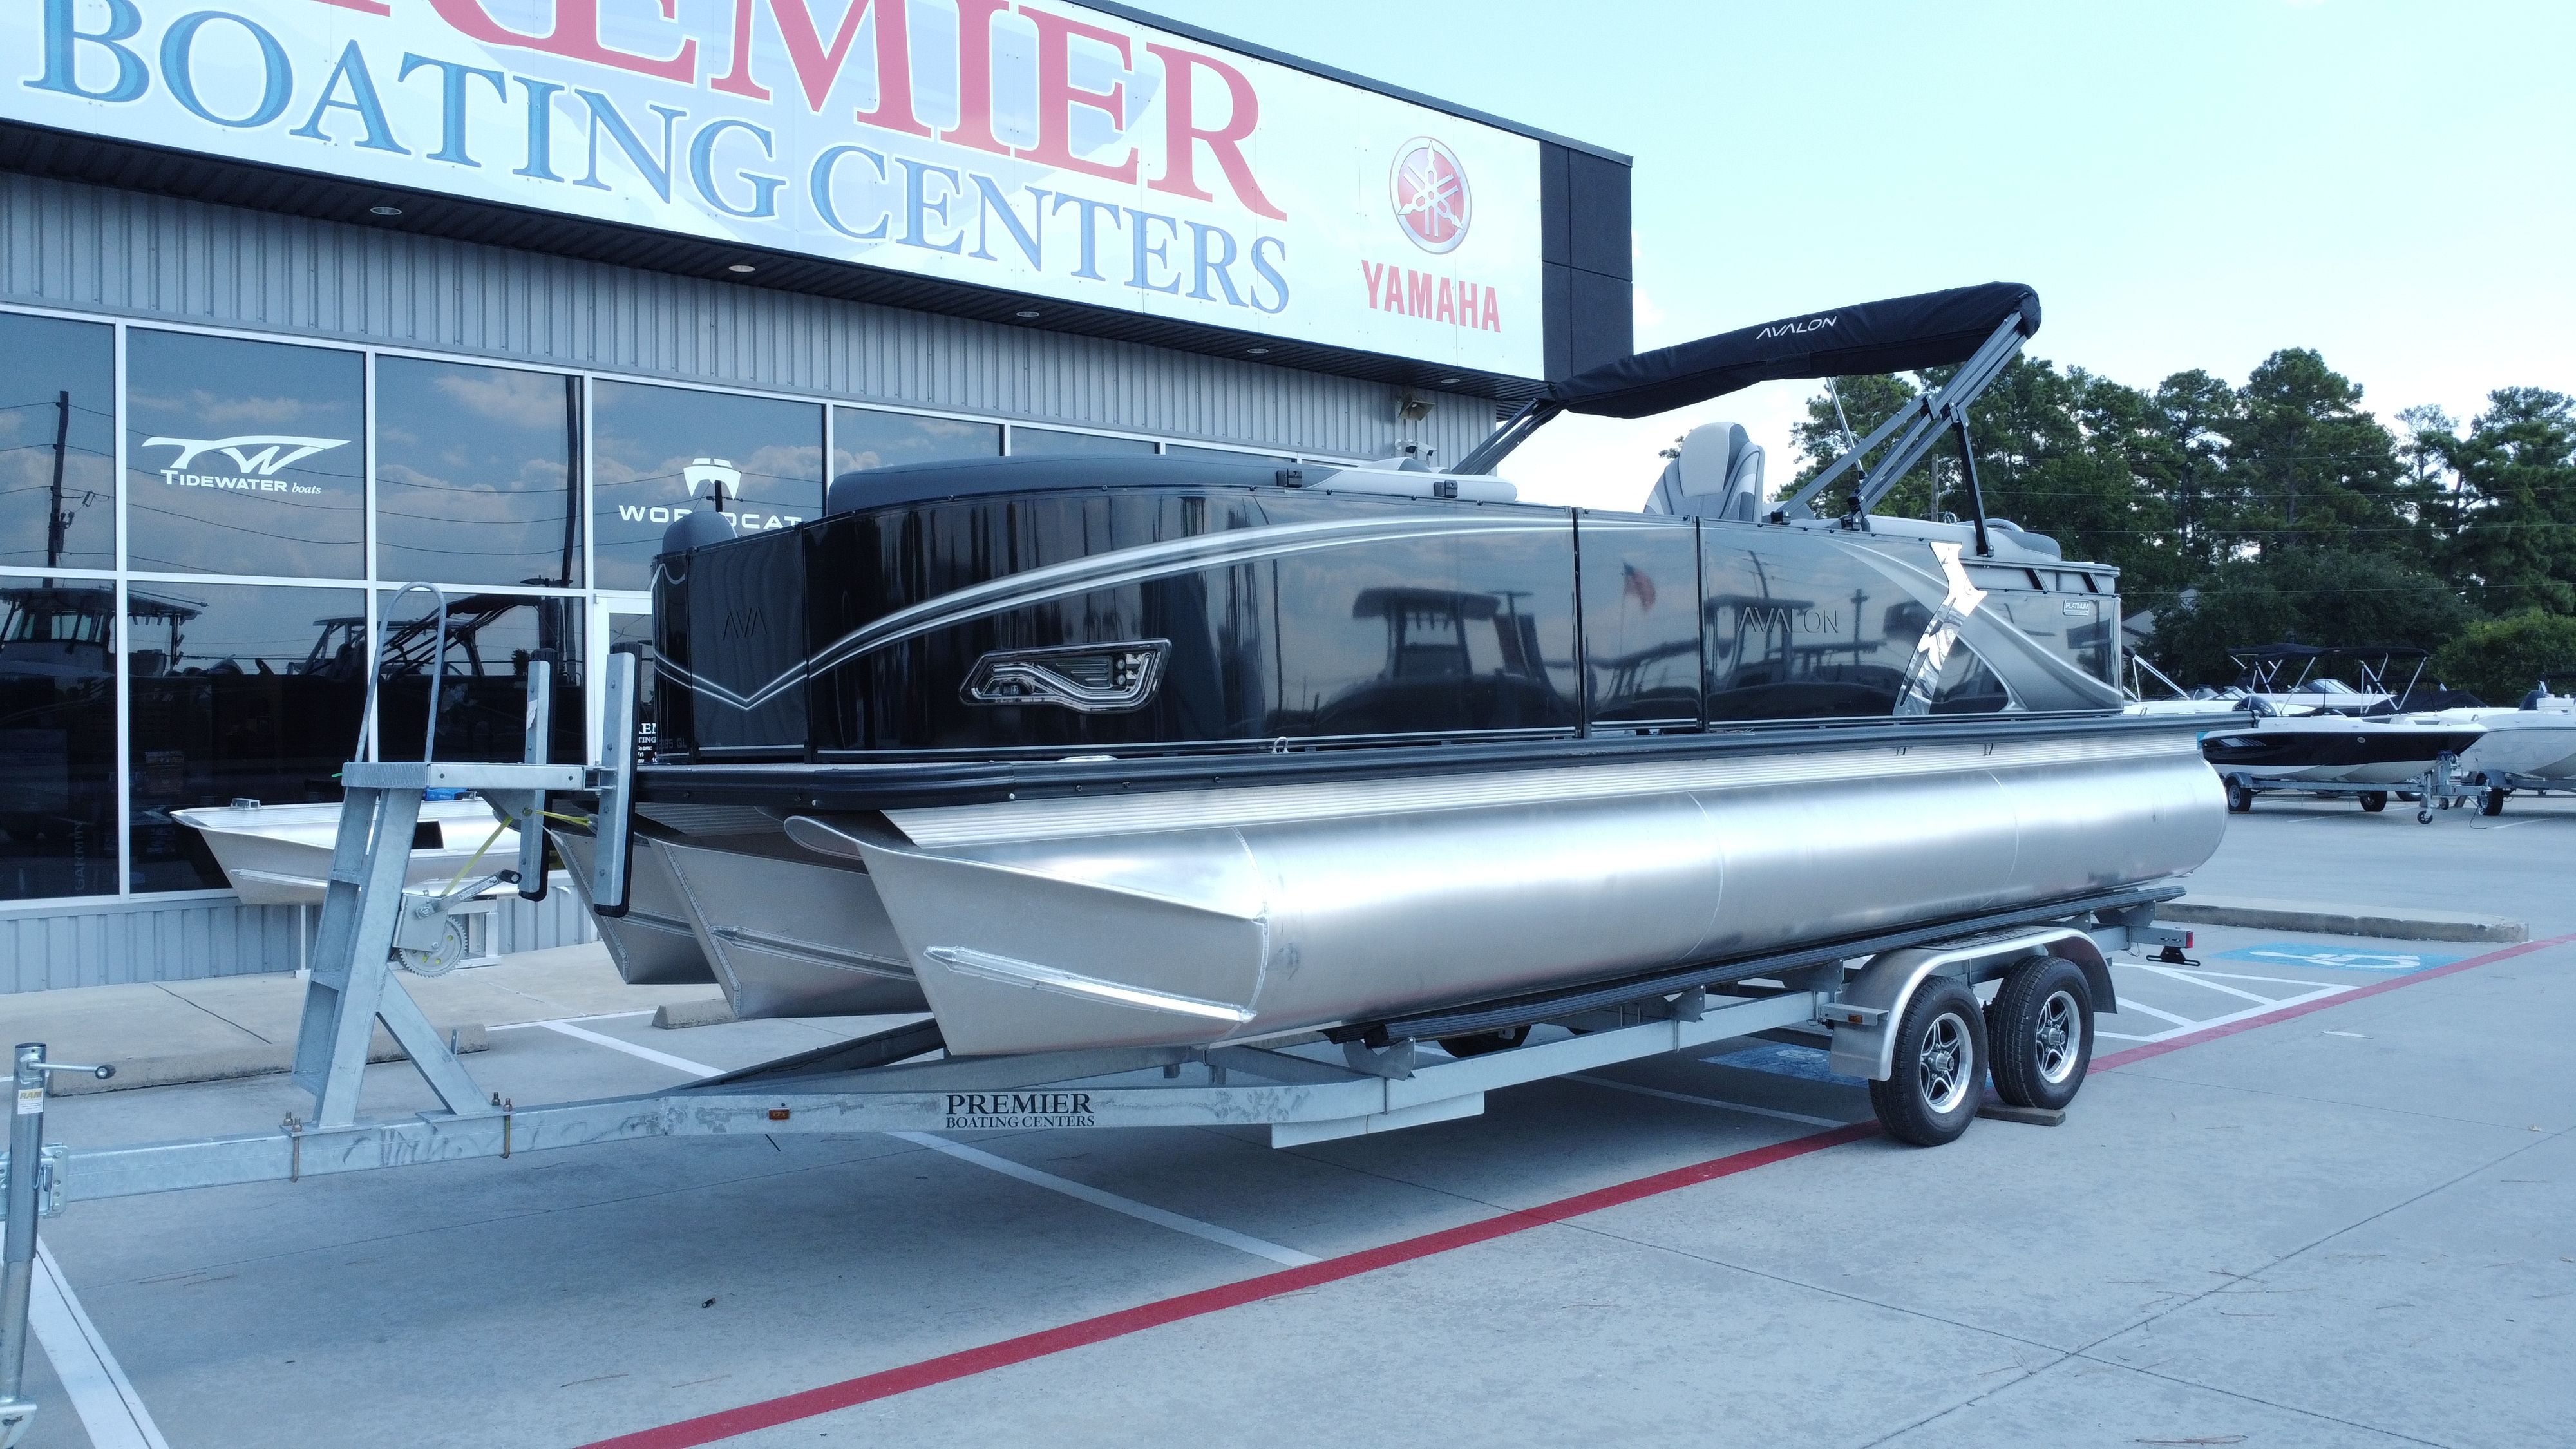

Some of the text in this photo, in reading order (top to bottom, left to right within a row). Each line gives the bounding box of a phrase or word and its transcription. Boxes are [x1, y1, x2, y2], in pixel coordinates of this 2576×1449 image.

[310, 0, 1287, 221] MIER
[23, 0, 1290, 314] BOATING CENTERS
[1361, 260, 1501, 334] YAMAHA
[1756, 316, 1837, 339] AVALON
[160, 469, 322, 495] TIDEWATER boats
[618, 505, 802, 529] WODCAT
[1738, 607, 1839, 634] AVALON
[945, 1093, 1094, 1115] PREMIER
[947, 1115, 1094, 1128] BOATING CENTERS
